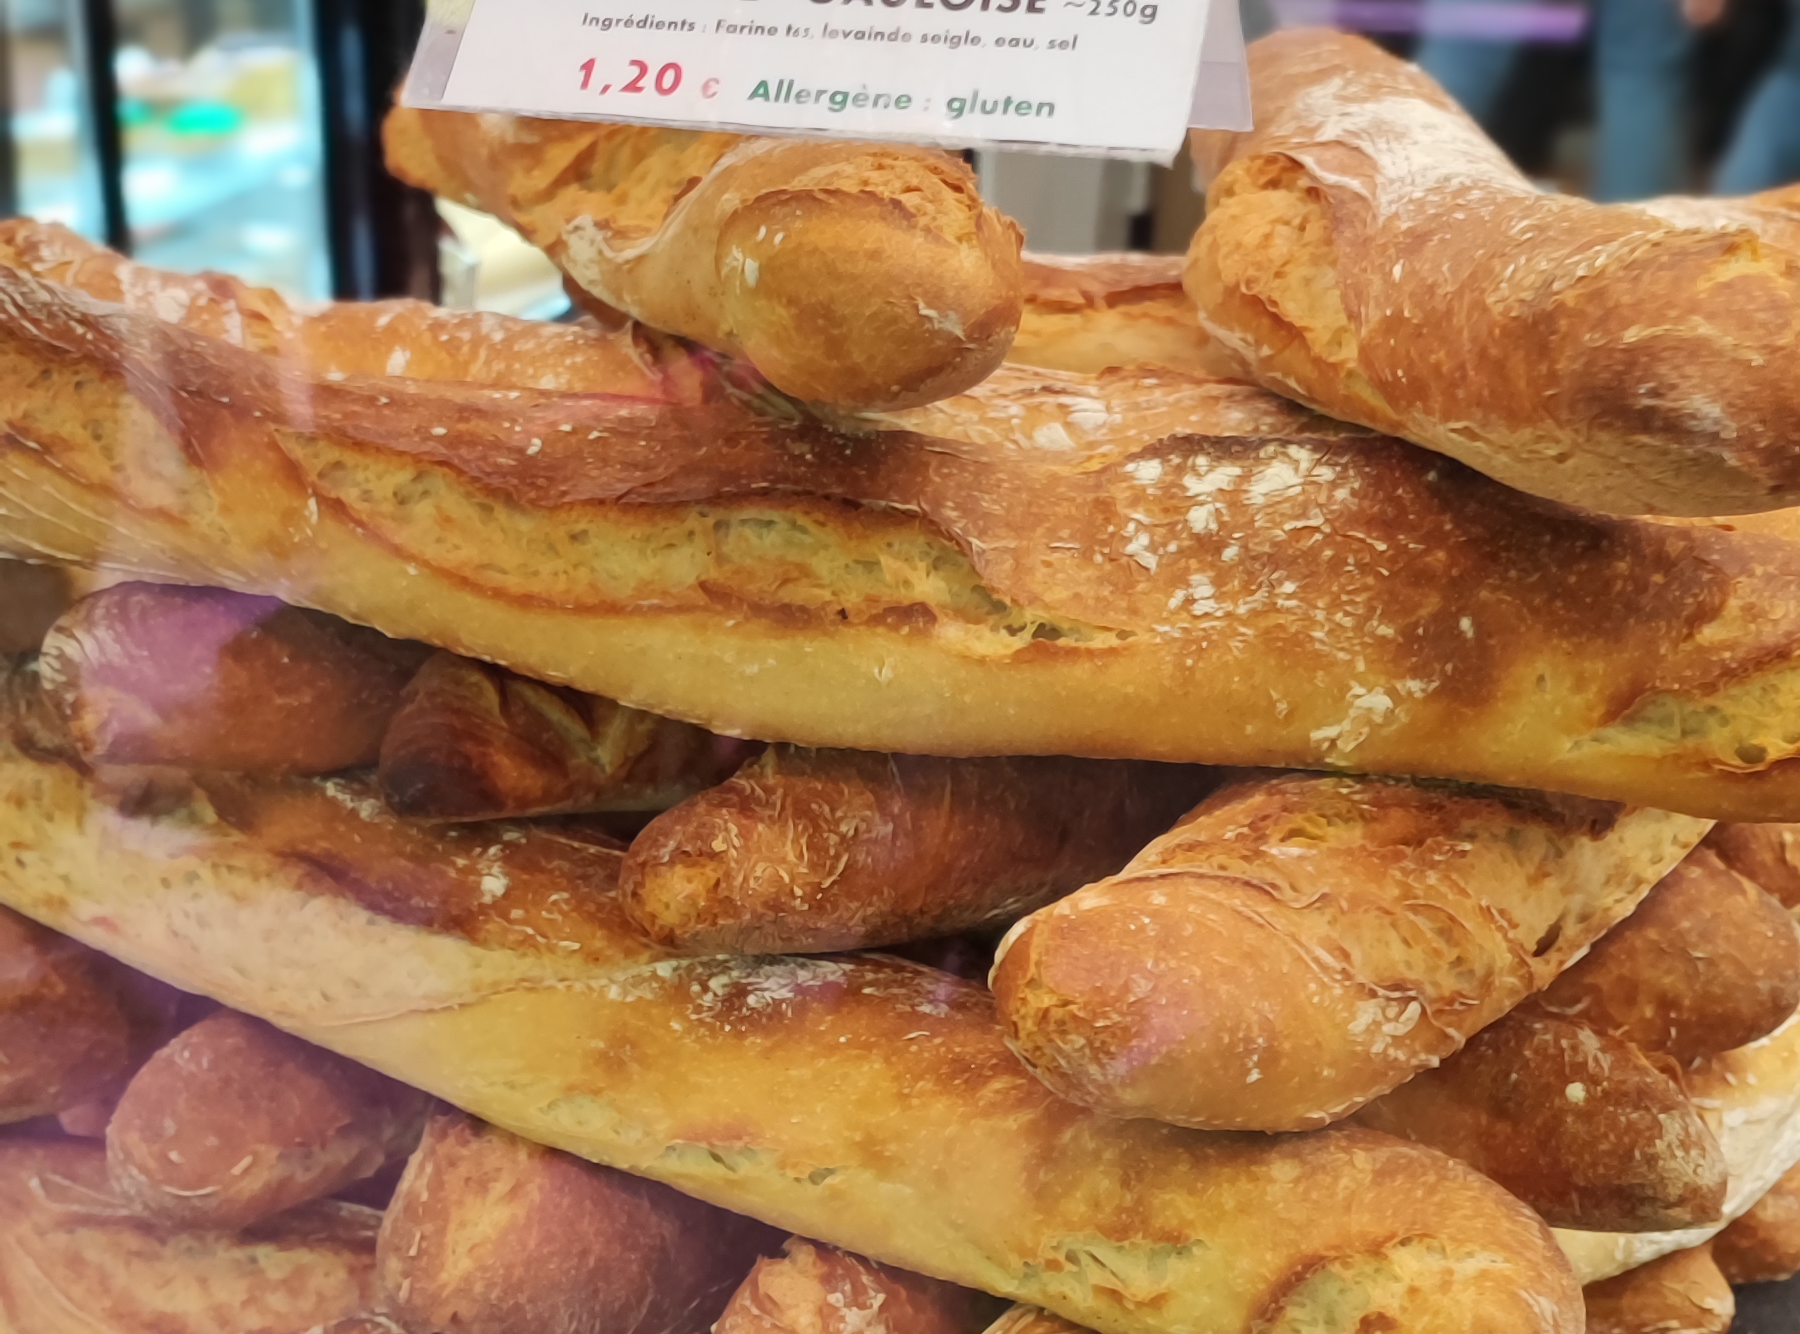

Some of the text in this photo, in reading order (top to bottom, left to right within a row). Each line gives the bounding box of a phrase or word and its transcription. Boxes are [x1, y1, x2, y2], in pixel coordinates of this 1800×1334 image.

[715, 19, 778, 38] Farine
[1046, 34, 1079, 51] sel
[579, 57, 684, 97] 1,20
[747, 79, 912, 113] Allergène
[947, 88, 1056, 120] gluten
